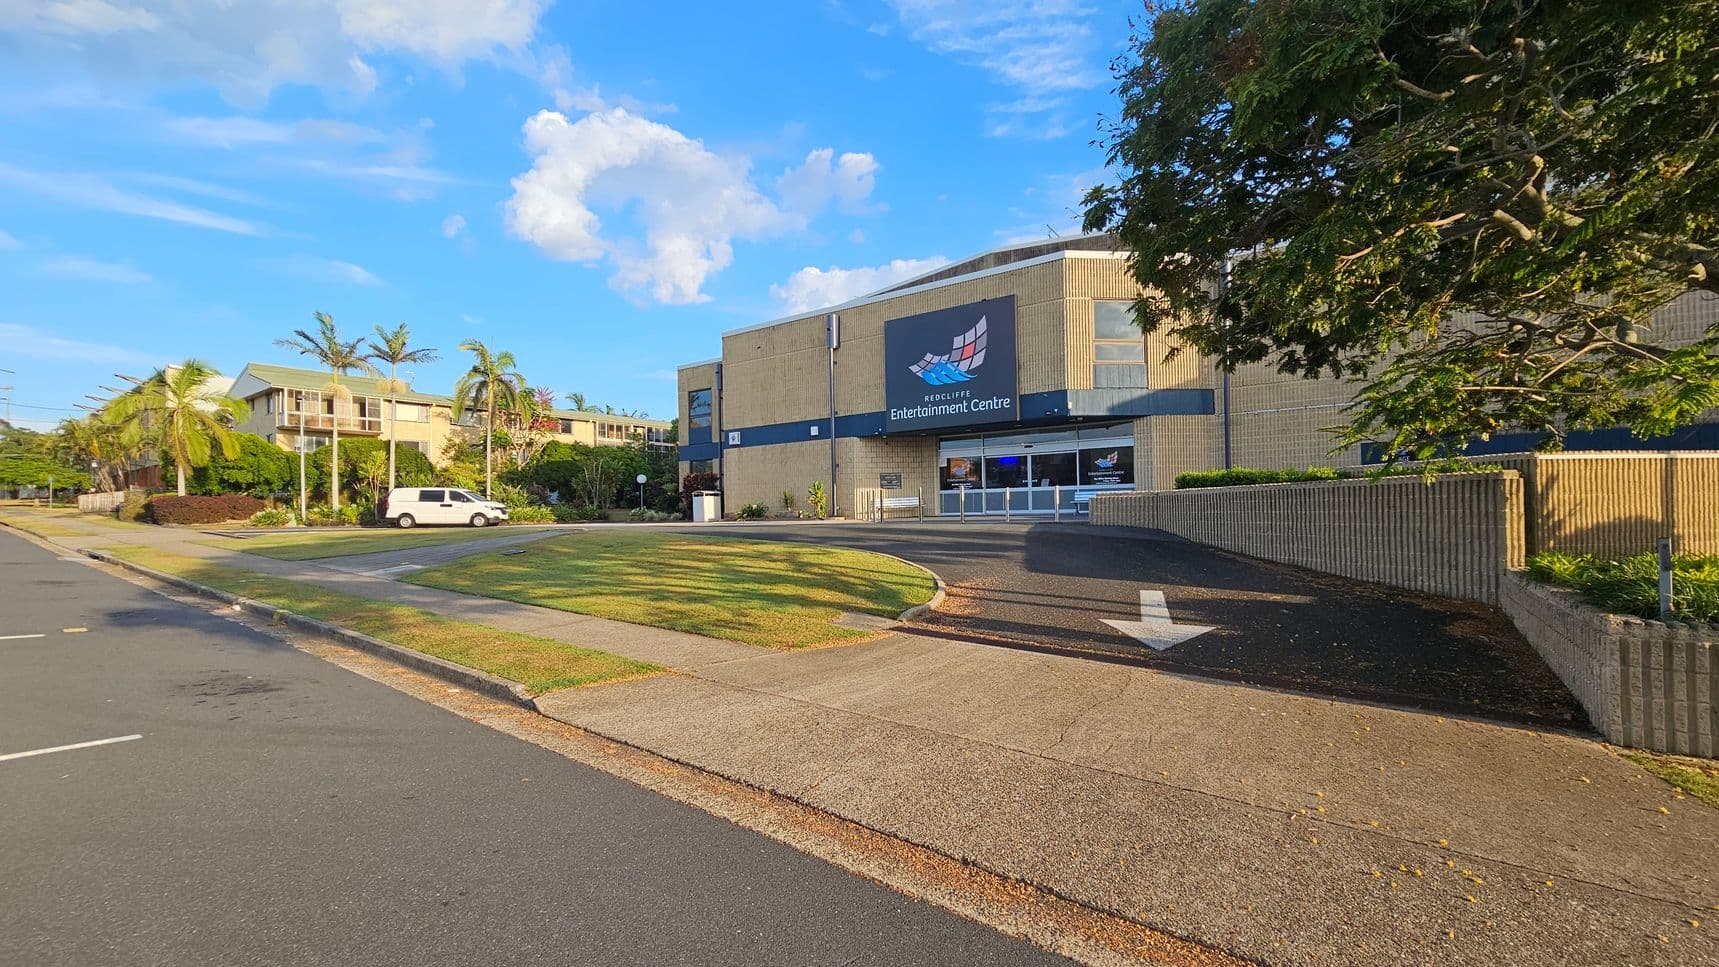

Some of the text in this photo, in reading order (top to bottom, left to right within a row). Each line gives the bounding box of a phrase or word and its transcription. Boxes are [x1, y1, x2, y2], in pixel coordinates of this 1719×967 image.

[924, 390, 971, 402] REDCLIFFE
[890, 396, 1010, 420] Entertainment Centre
